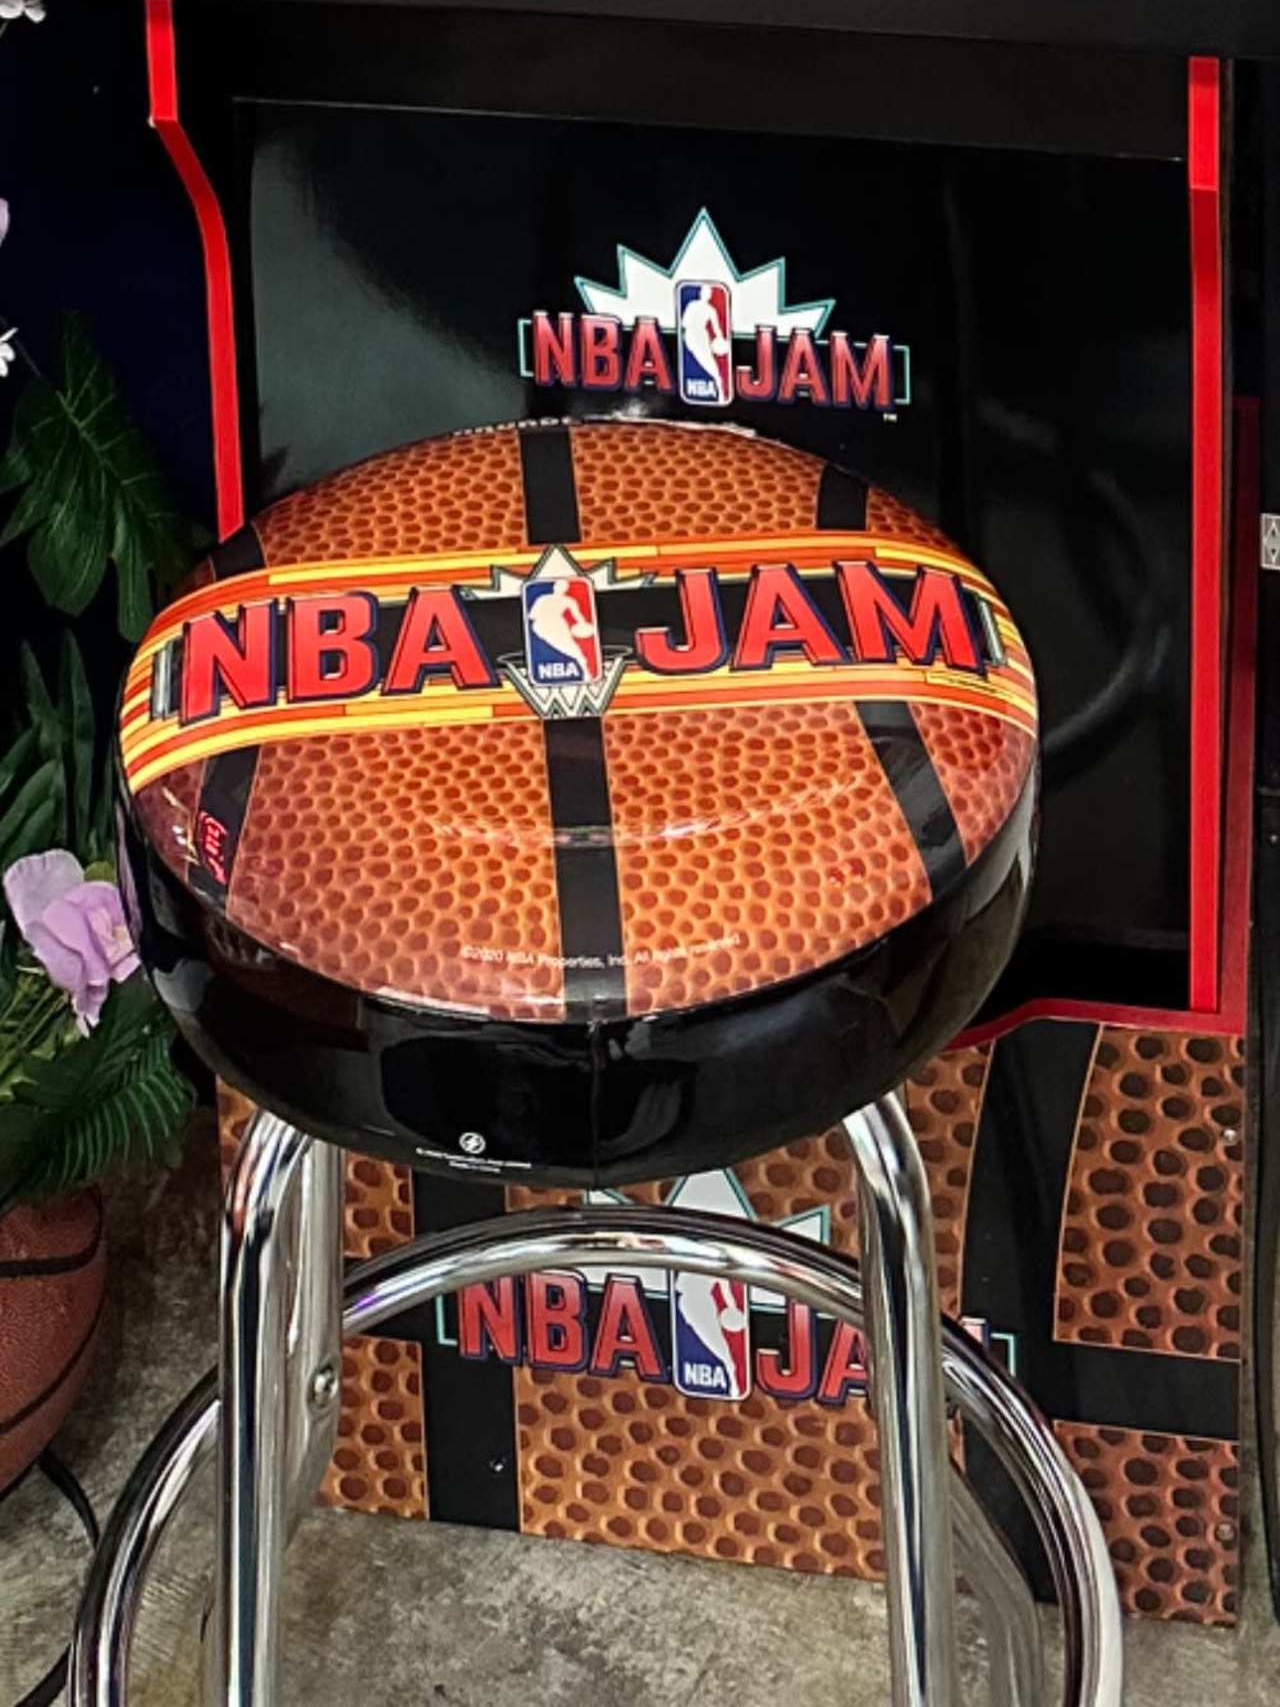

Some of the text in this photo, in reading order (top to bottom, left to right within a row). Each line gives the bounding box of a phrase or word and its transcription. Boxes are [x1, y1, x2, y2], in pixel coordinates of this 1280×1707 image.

[532, 311, 894, 408] NBA JAM
[686, 380, 717, 396] NBA
[180, 560, 988, 724] NBA JAM
[539, 664, 580, 680] NBA
[506, 951, 534, 965] NBA
[538, 954, 605, 969] Properties,
[458, 1266, 669, 1382] NBA
[684, 1366, 725, 1388] NBA
